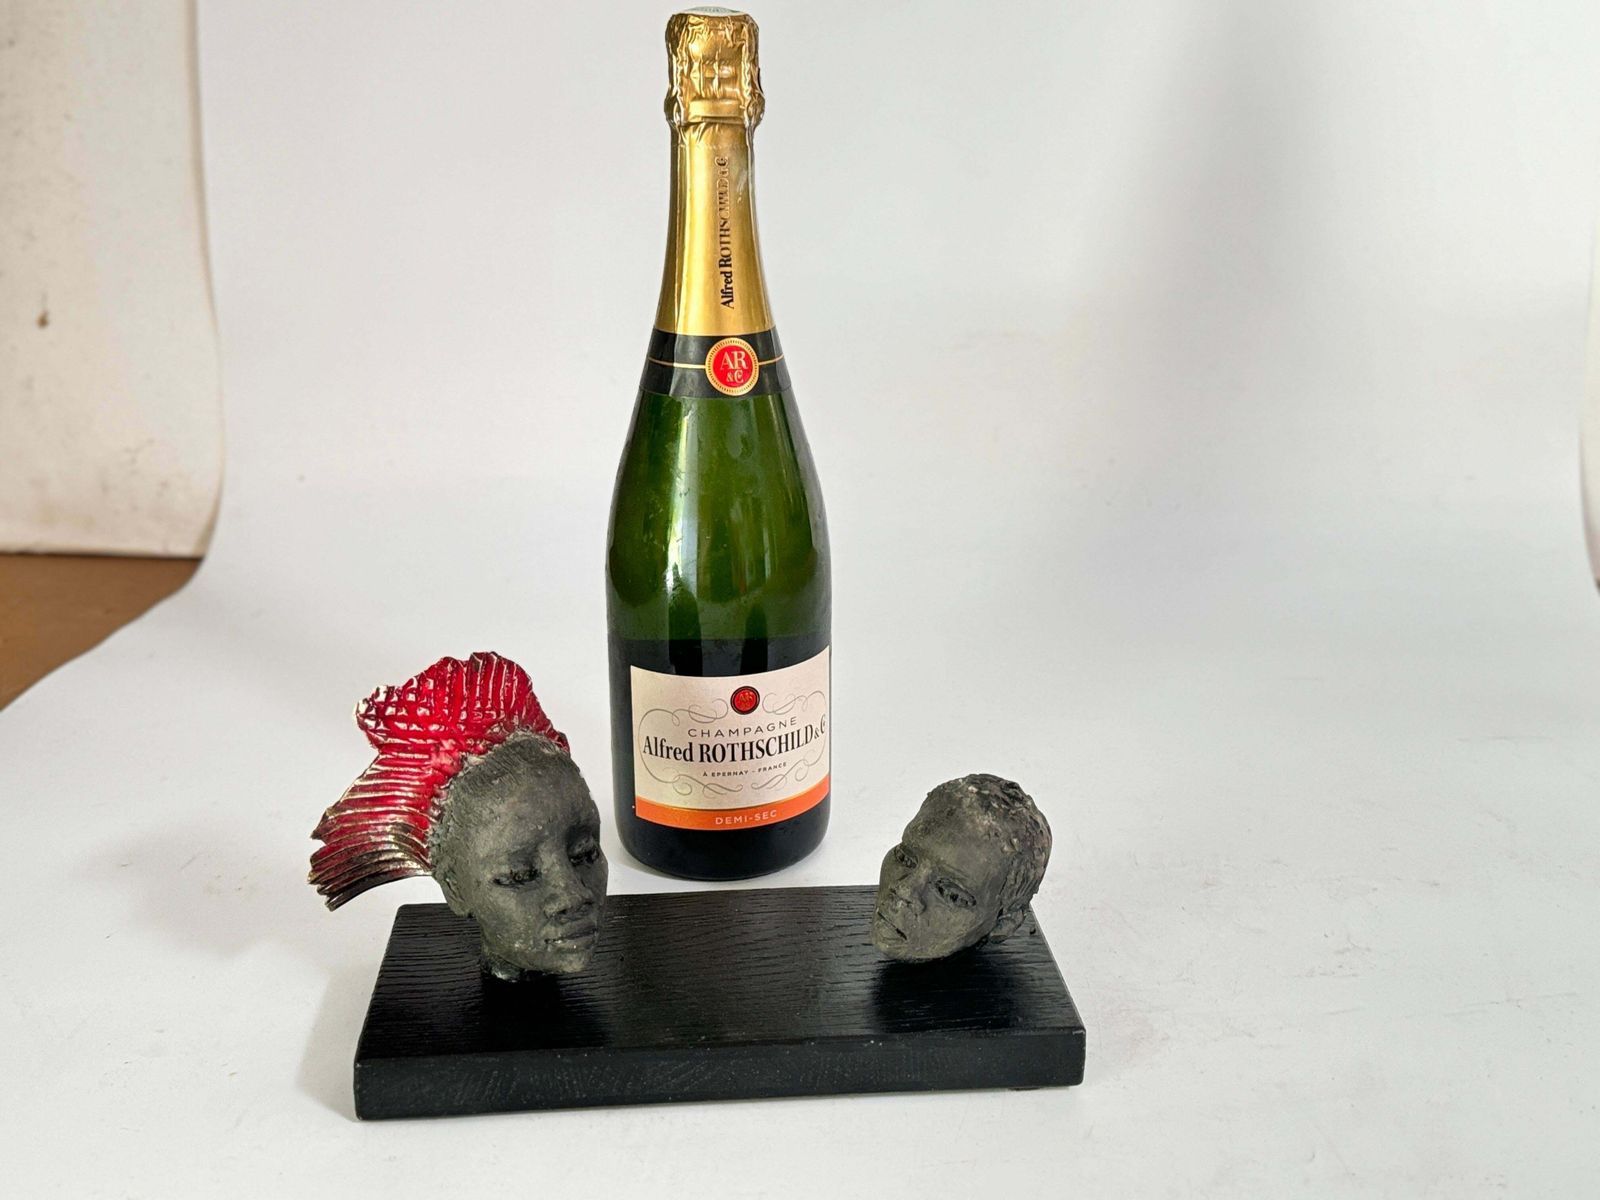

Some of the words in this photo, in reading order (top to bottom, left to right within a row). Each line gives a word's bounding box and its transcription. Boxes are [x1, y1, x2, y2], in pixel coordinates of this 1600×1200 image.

[720, 271, 734, 310] Alfred
[720, 351, 748, 370] AR
[688, 716, 798, 738] CHAMPAGNE
[642, 735, 694, 762] Alfred
[758, 762, 787, 772] FRANCE
[715, 810, 777, 825] DEMI-SEC
